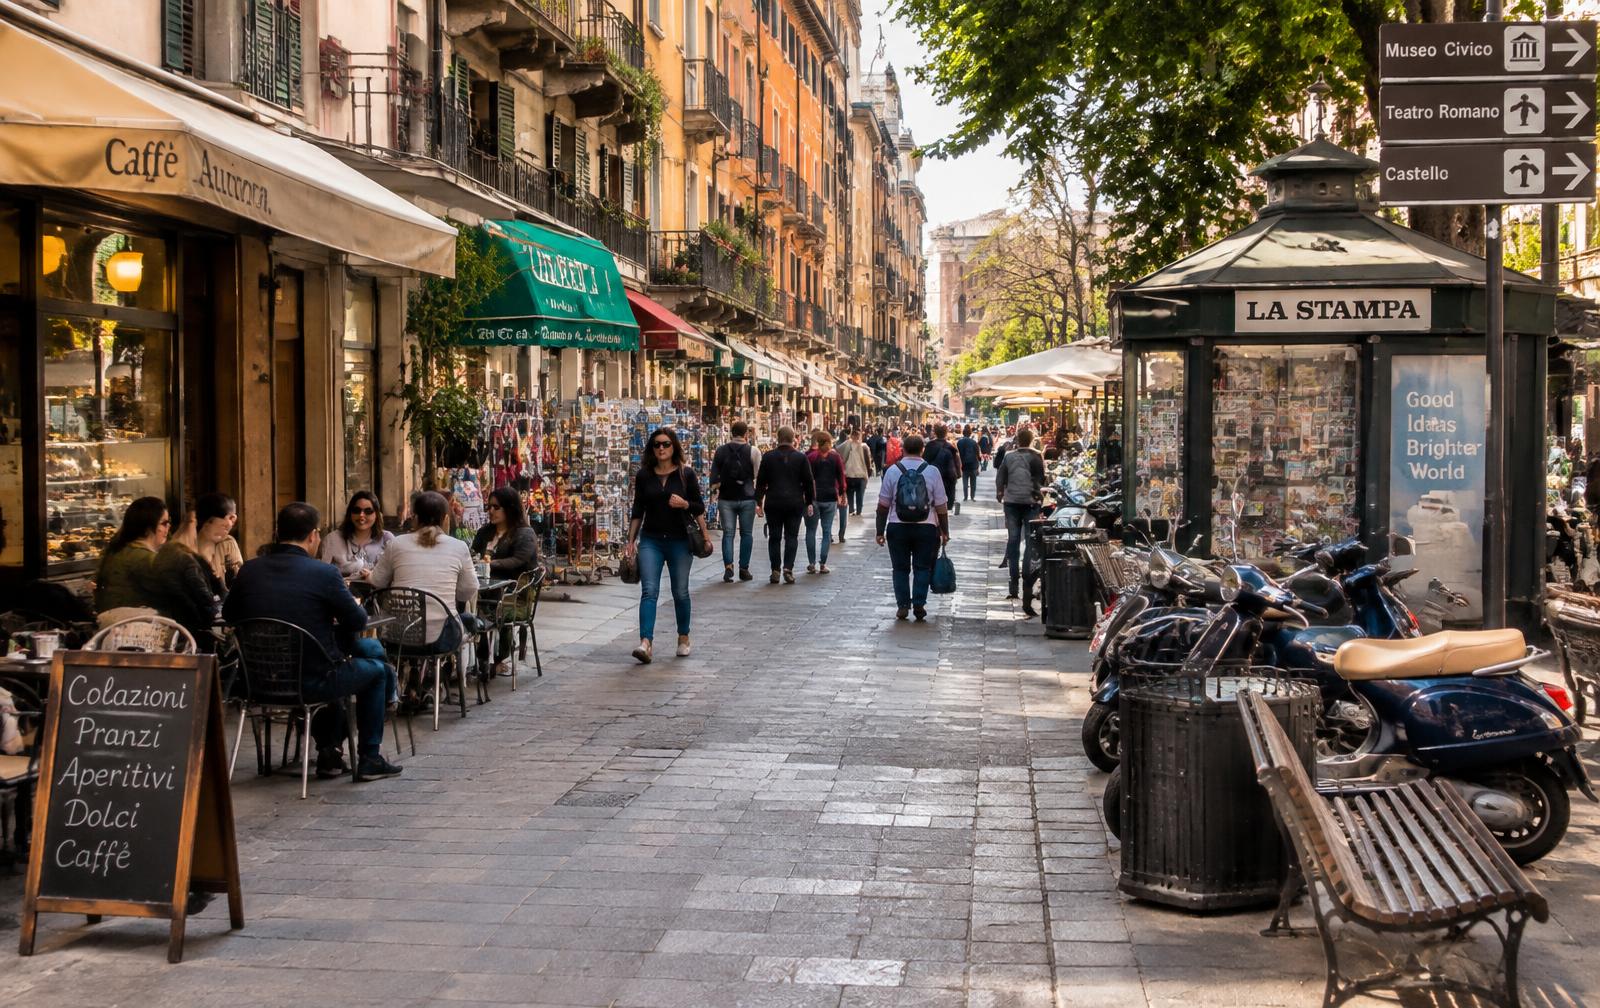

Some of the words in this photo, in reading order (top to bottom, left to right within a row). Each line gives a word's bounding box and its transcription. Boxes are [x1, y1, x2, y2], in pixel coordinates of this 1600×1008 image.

[1385, 42, 1437, 58] Museo
[1444, 41, 1493, 57] Civico
[1385, 105, 1434, 120] Teatro
[1439, 104, 1500, 119] Romano
[1385, 166, 1449, 181] Castello
[1246, 301, 1288, 320] LA
[1296, 300, 1421, 320] STAMPA
[1406, 390, 1454, 408] Good
[1407, 438, 1483, 460] Brighter
[1407, 461, 1465, 480] World
[67, 674, 188, 710] Colazioni
[73, 717, 163, 748] Pranzi
[64, 798, 141, 829] Dolci
